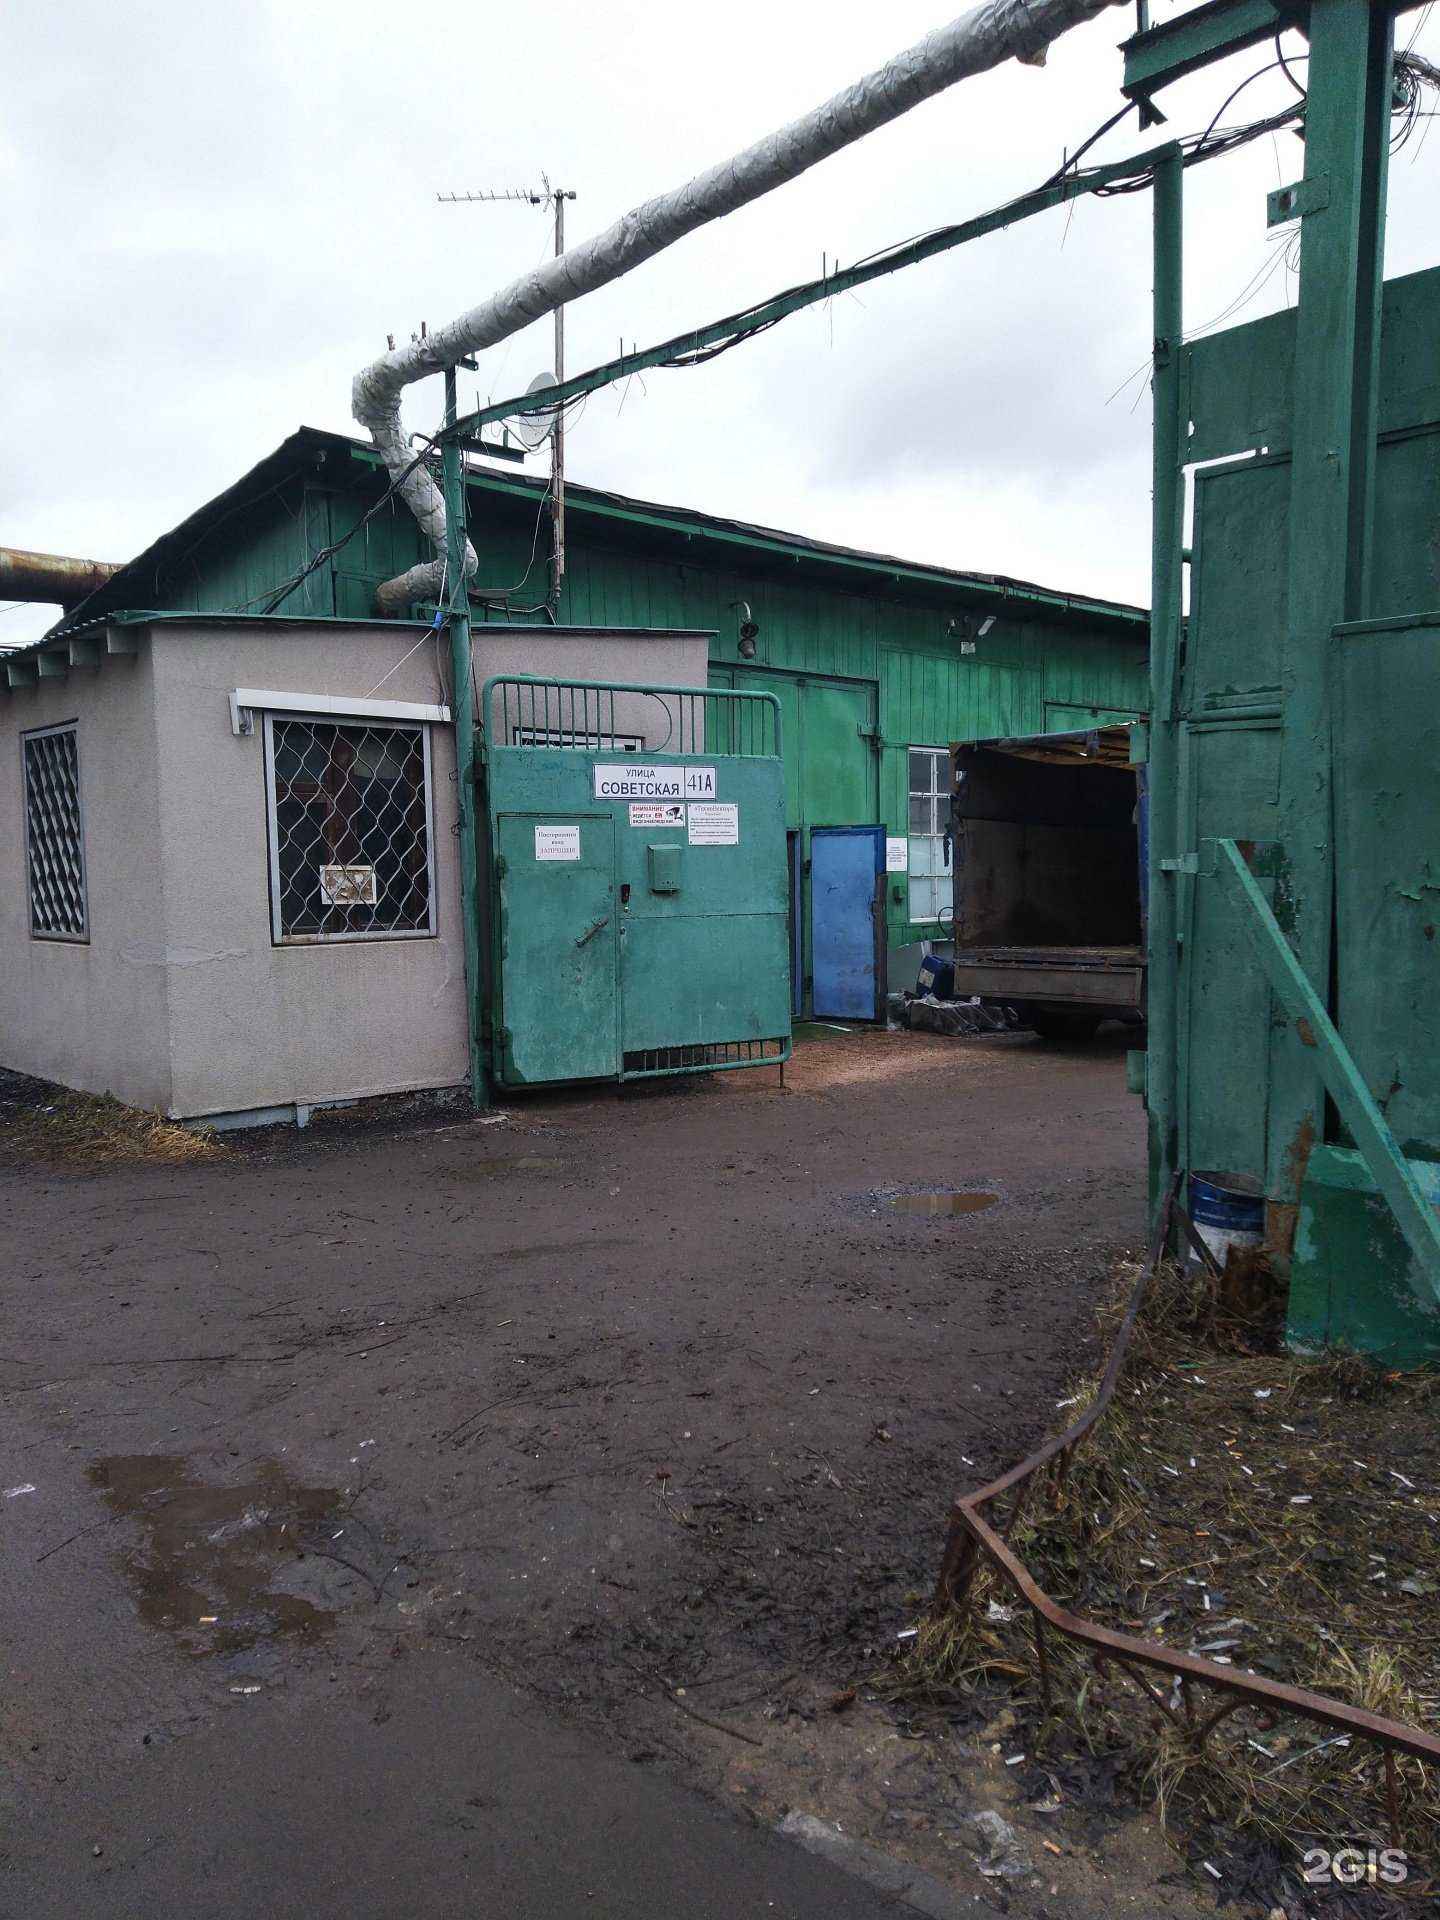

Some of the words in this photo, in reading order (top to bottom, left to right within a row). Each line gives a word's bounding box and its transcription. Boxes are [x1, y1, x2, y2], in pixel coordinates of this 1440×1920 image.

[626, 768, 656, 778] УЛИЦА
[601, 782, 680, 795] СОВЕТСКАЯ
[687, 774, 713, 791] 41А
